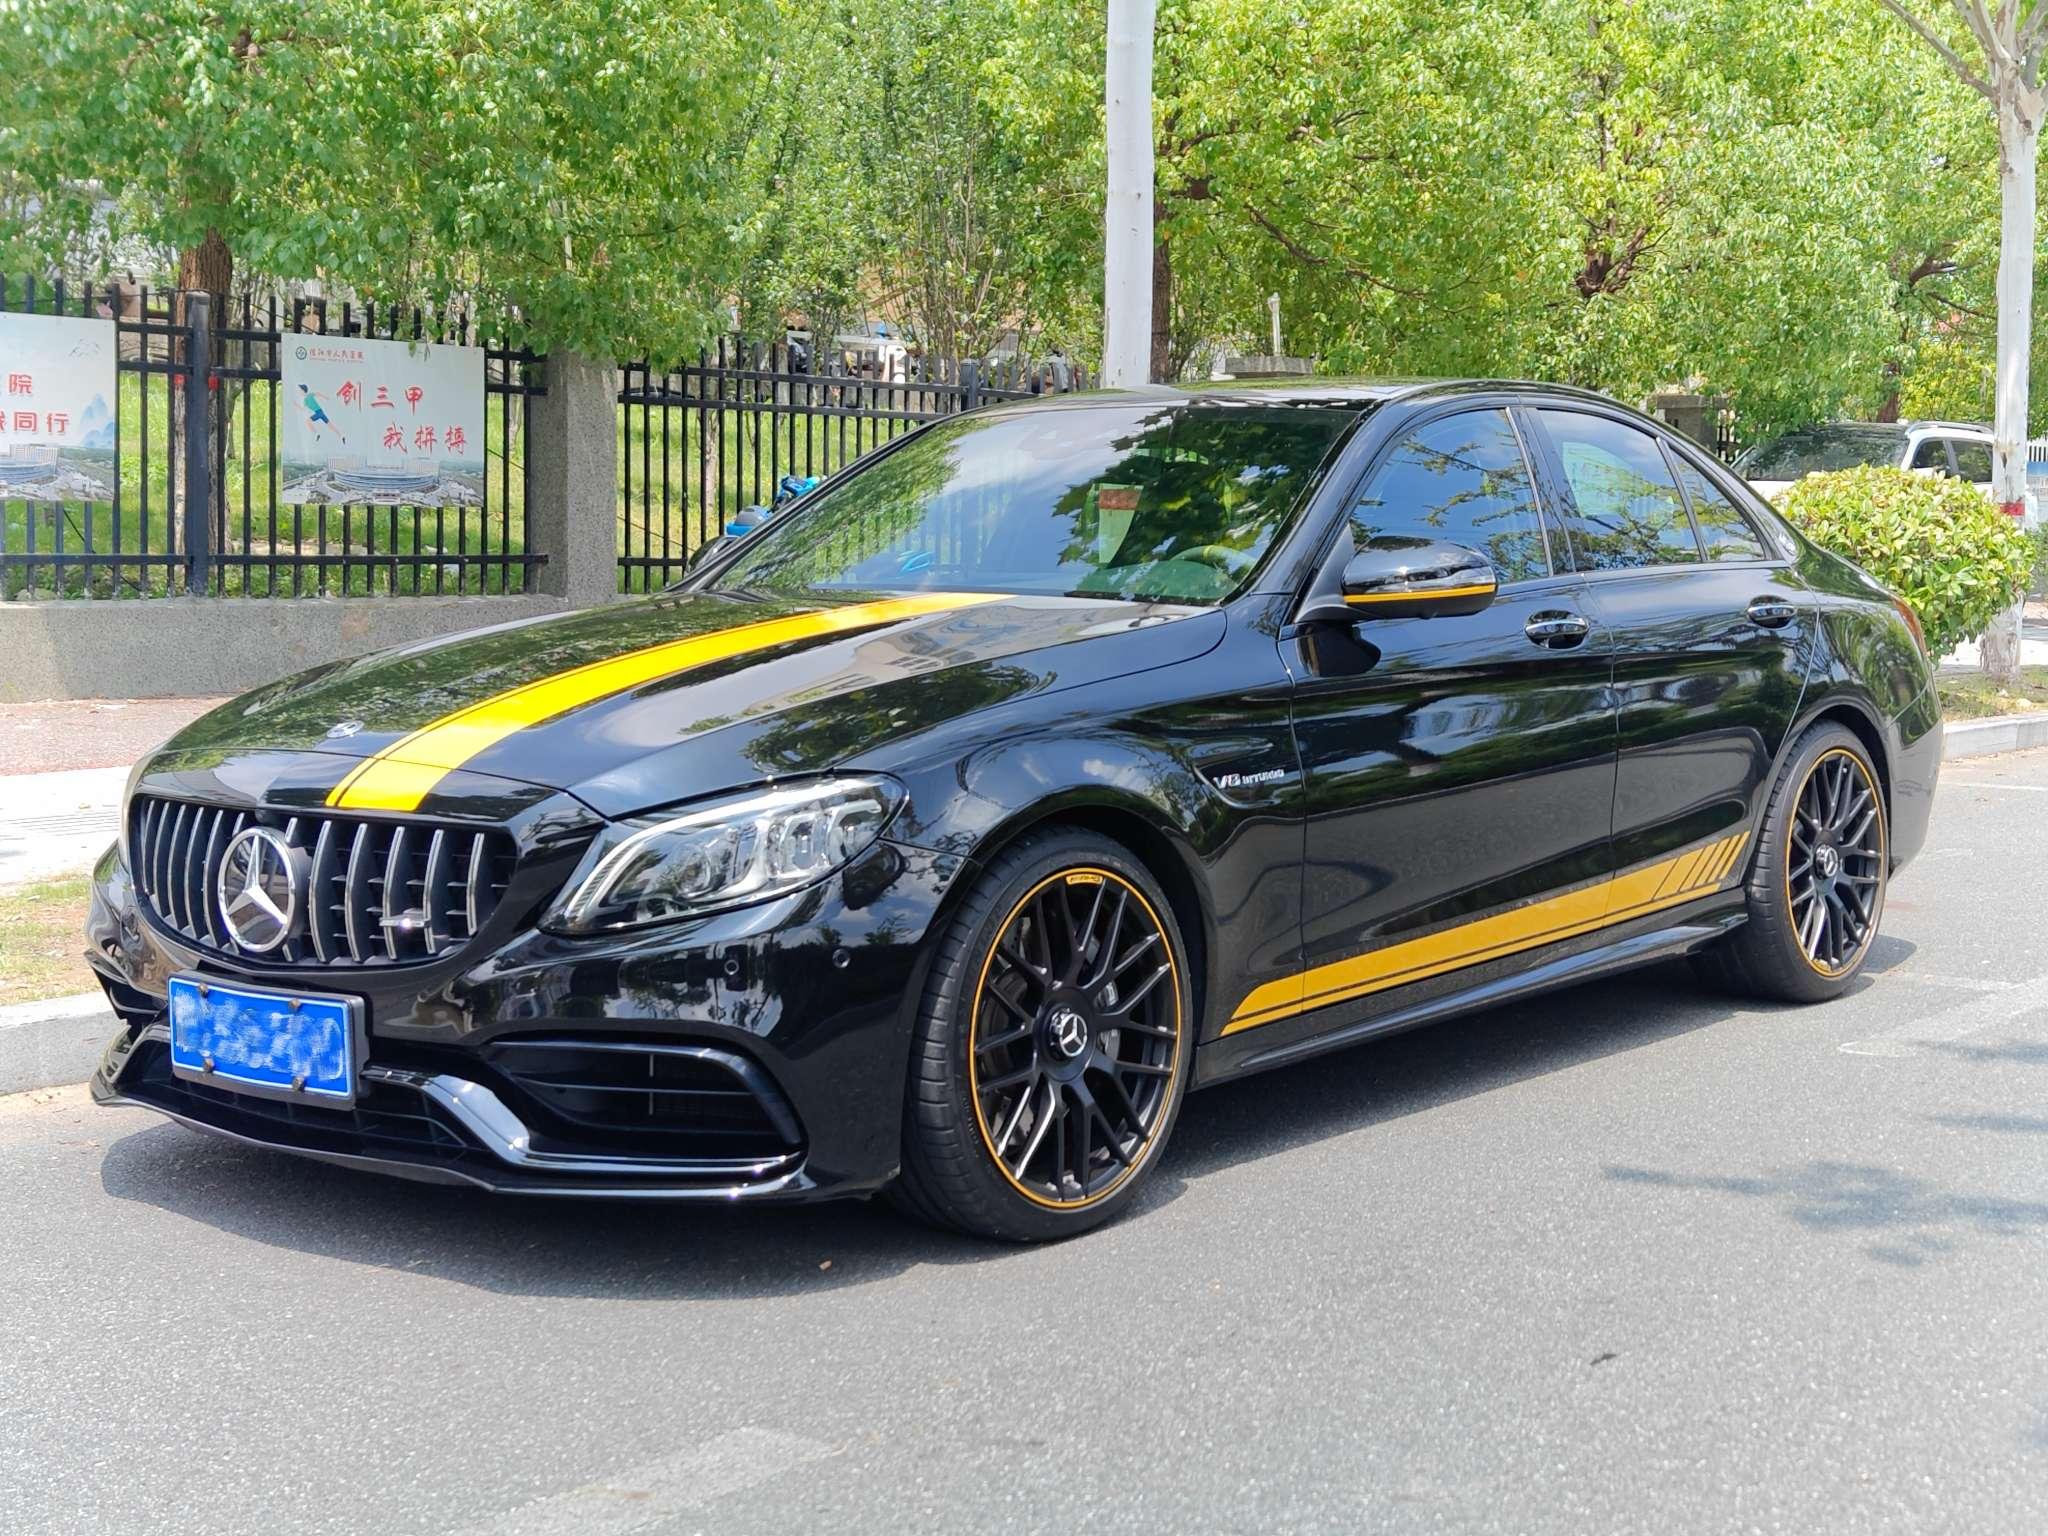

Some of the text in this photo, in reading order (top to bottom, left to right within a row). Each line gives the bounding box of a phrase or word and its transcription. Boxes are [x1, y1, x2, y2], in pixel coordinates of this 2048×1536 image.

[9, 373, 33, 394] 院
[336, 380, 424, 416] 创三甲
[383, 421, 467, 455] 我拼搏
